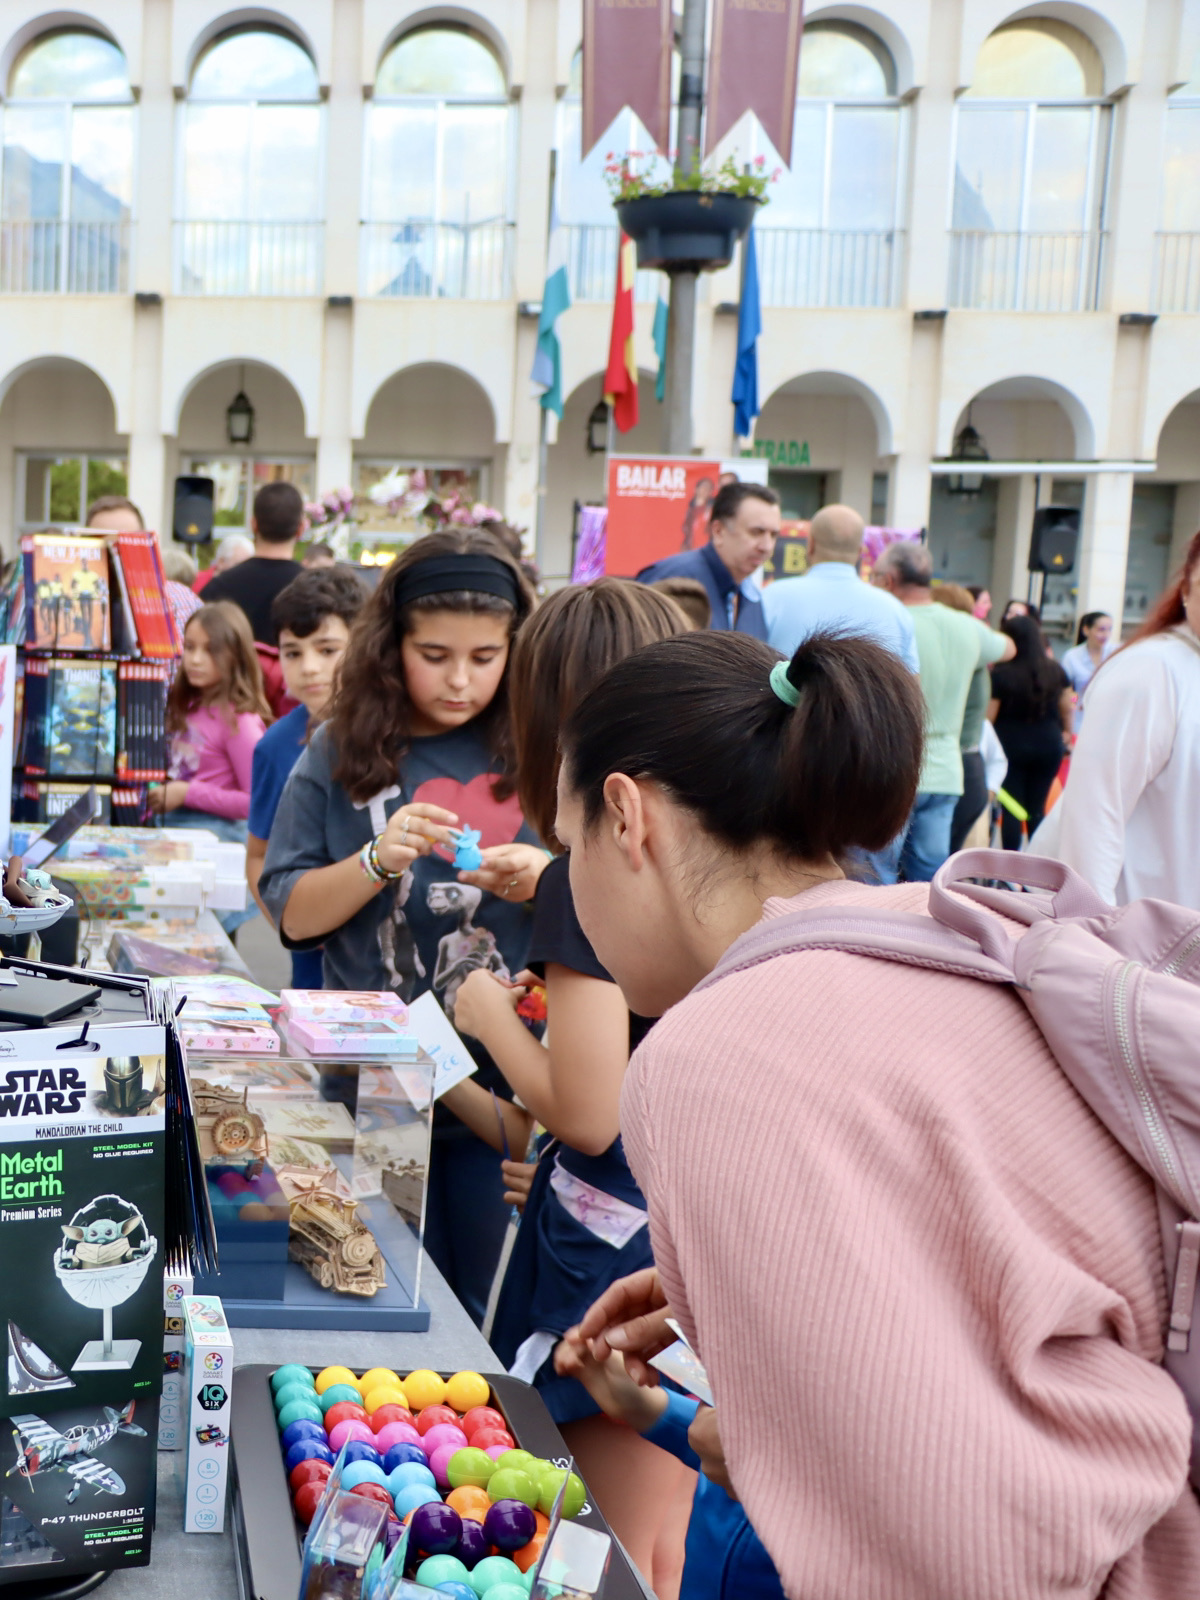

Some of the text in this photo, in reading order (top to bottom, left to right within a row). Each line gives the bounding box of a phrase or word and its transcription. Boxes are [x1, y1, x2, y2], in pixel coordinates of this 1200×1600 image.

[615, 464, 687, 489] BAILAR
[43, 545, 66, 559] NEW
[35, 1125, 86, 1139] MANDALORIAN
[88, 1124, 102, 1133] THE
[122, 1148, 154, 1157] REQUIRED
[0, 1149, 63, 1176] Metal
[1, 1206, 63, 1222] Premium Series
[203, 1385, 225, 1401] IQ
[206, 1462, 211, 1470] 8
[41, 1507, 145, 1525] P-47 THUNDERBOLT
[84, 1531, 106, 1539] STEEL
[107, 1529, 131, 1537] MODEL
[95, 1537, 112, 1545] GLUE
[113, 1534, 143, 1543] REQUIRED
